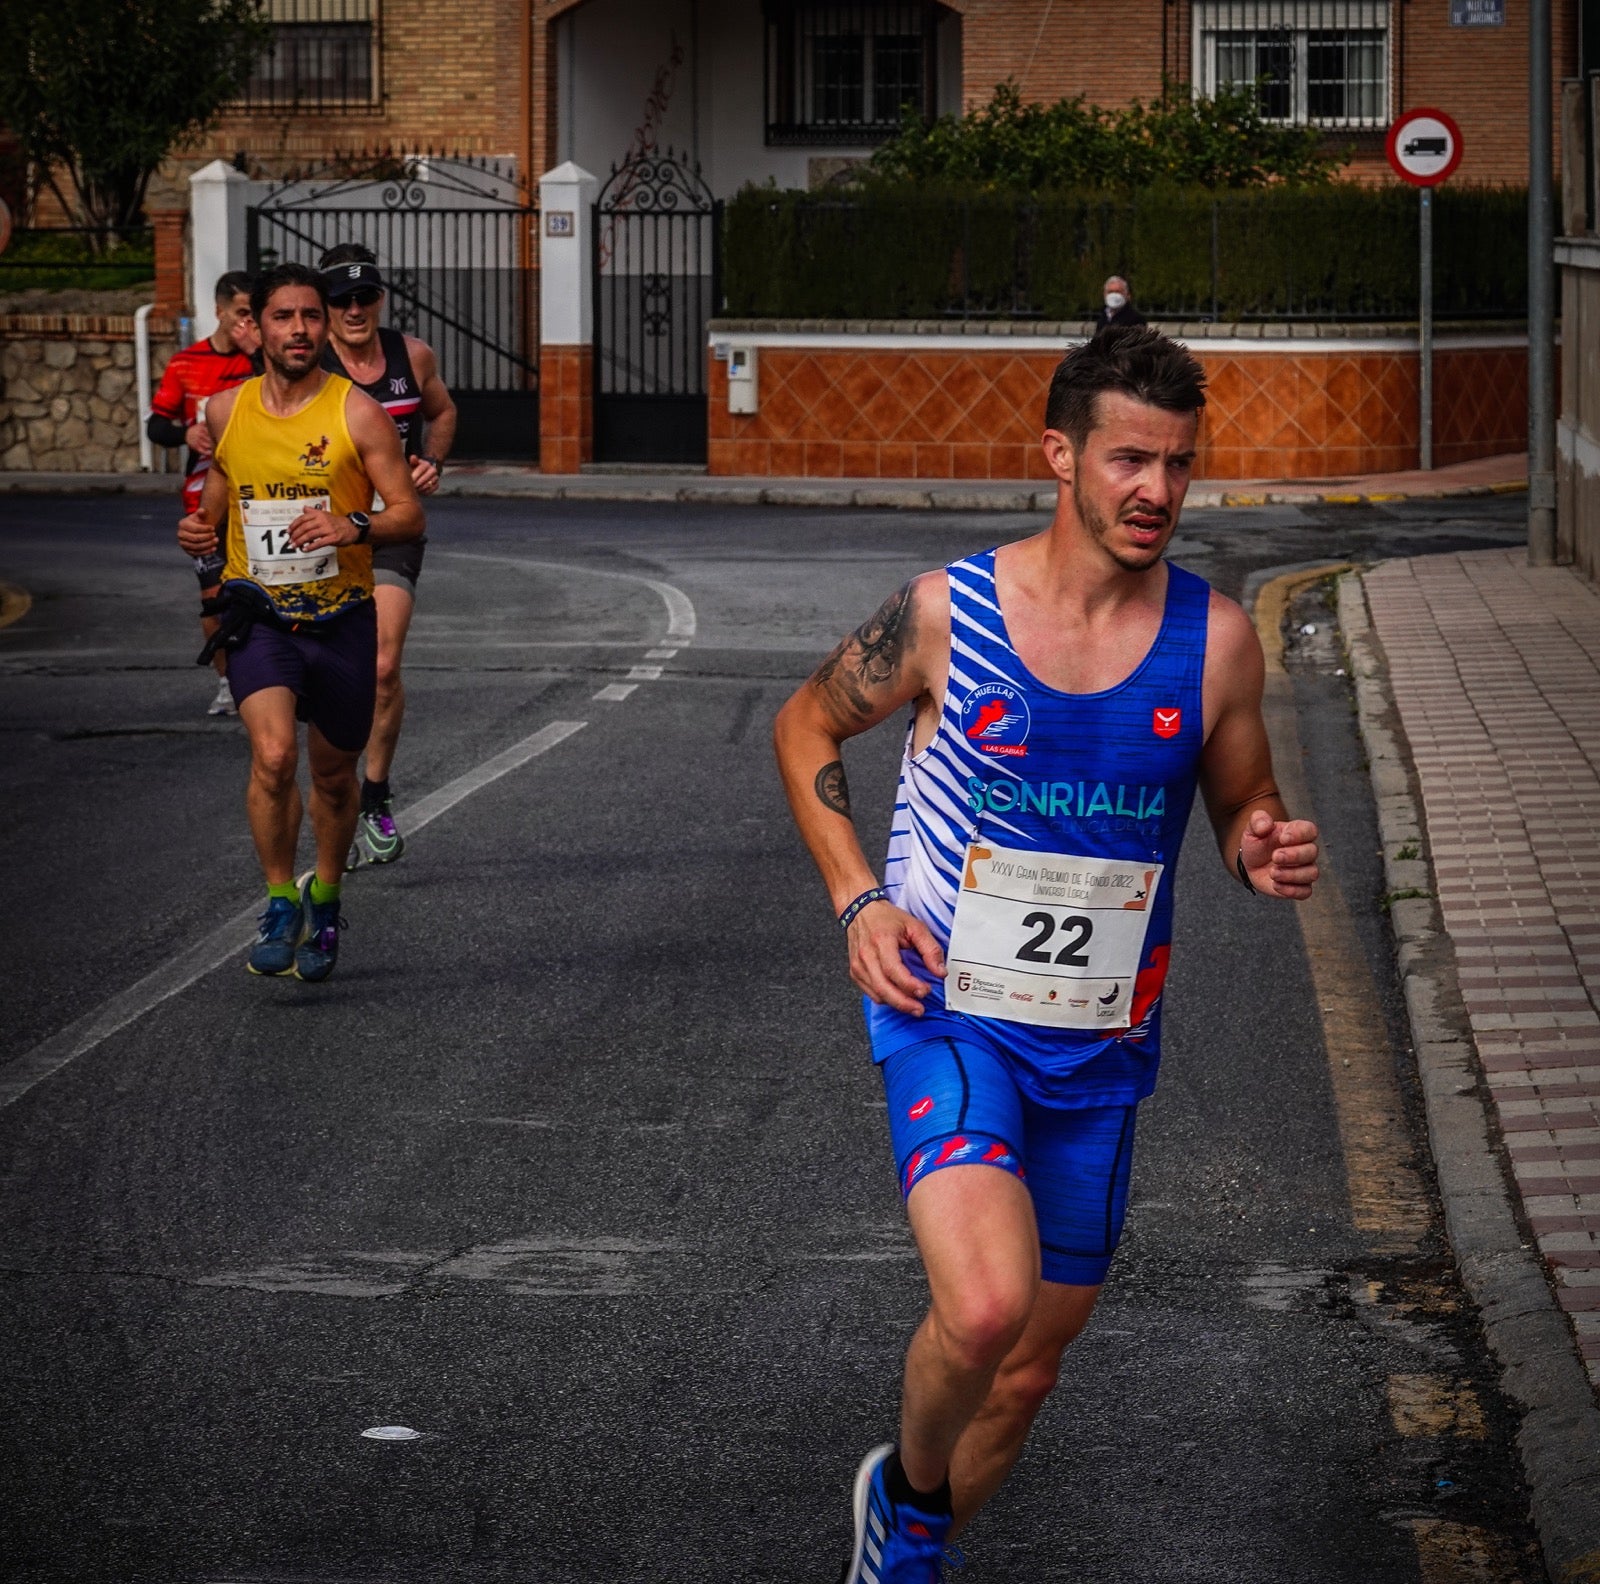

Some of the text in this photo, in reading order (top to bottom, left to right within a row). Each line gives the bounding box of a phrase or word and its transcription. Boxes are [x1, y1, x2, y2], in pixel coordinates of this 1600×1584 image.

[261, 529, 310, 555] 12
[974, 685, 1015, 699] HUELLAS
[1000, 747, 1025, 756] GABIAS
[967, 776, 1165, 819] SONRIALIA
[1110, 874, 1135, 889] 2022
[1015, 911, 1093, 967] 22
